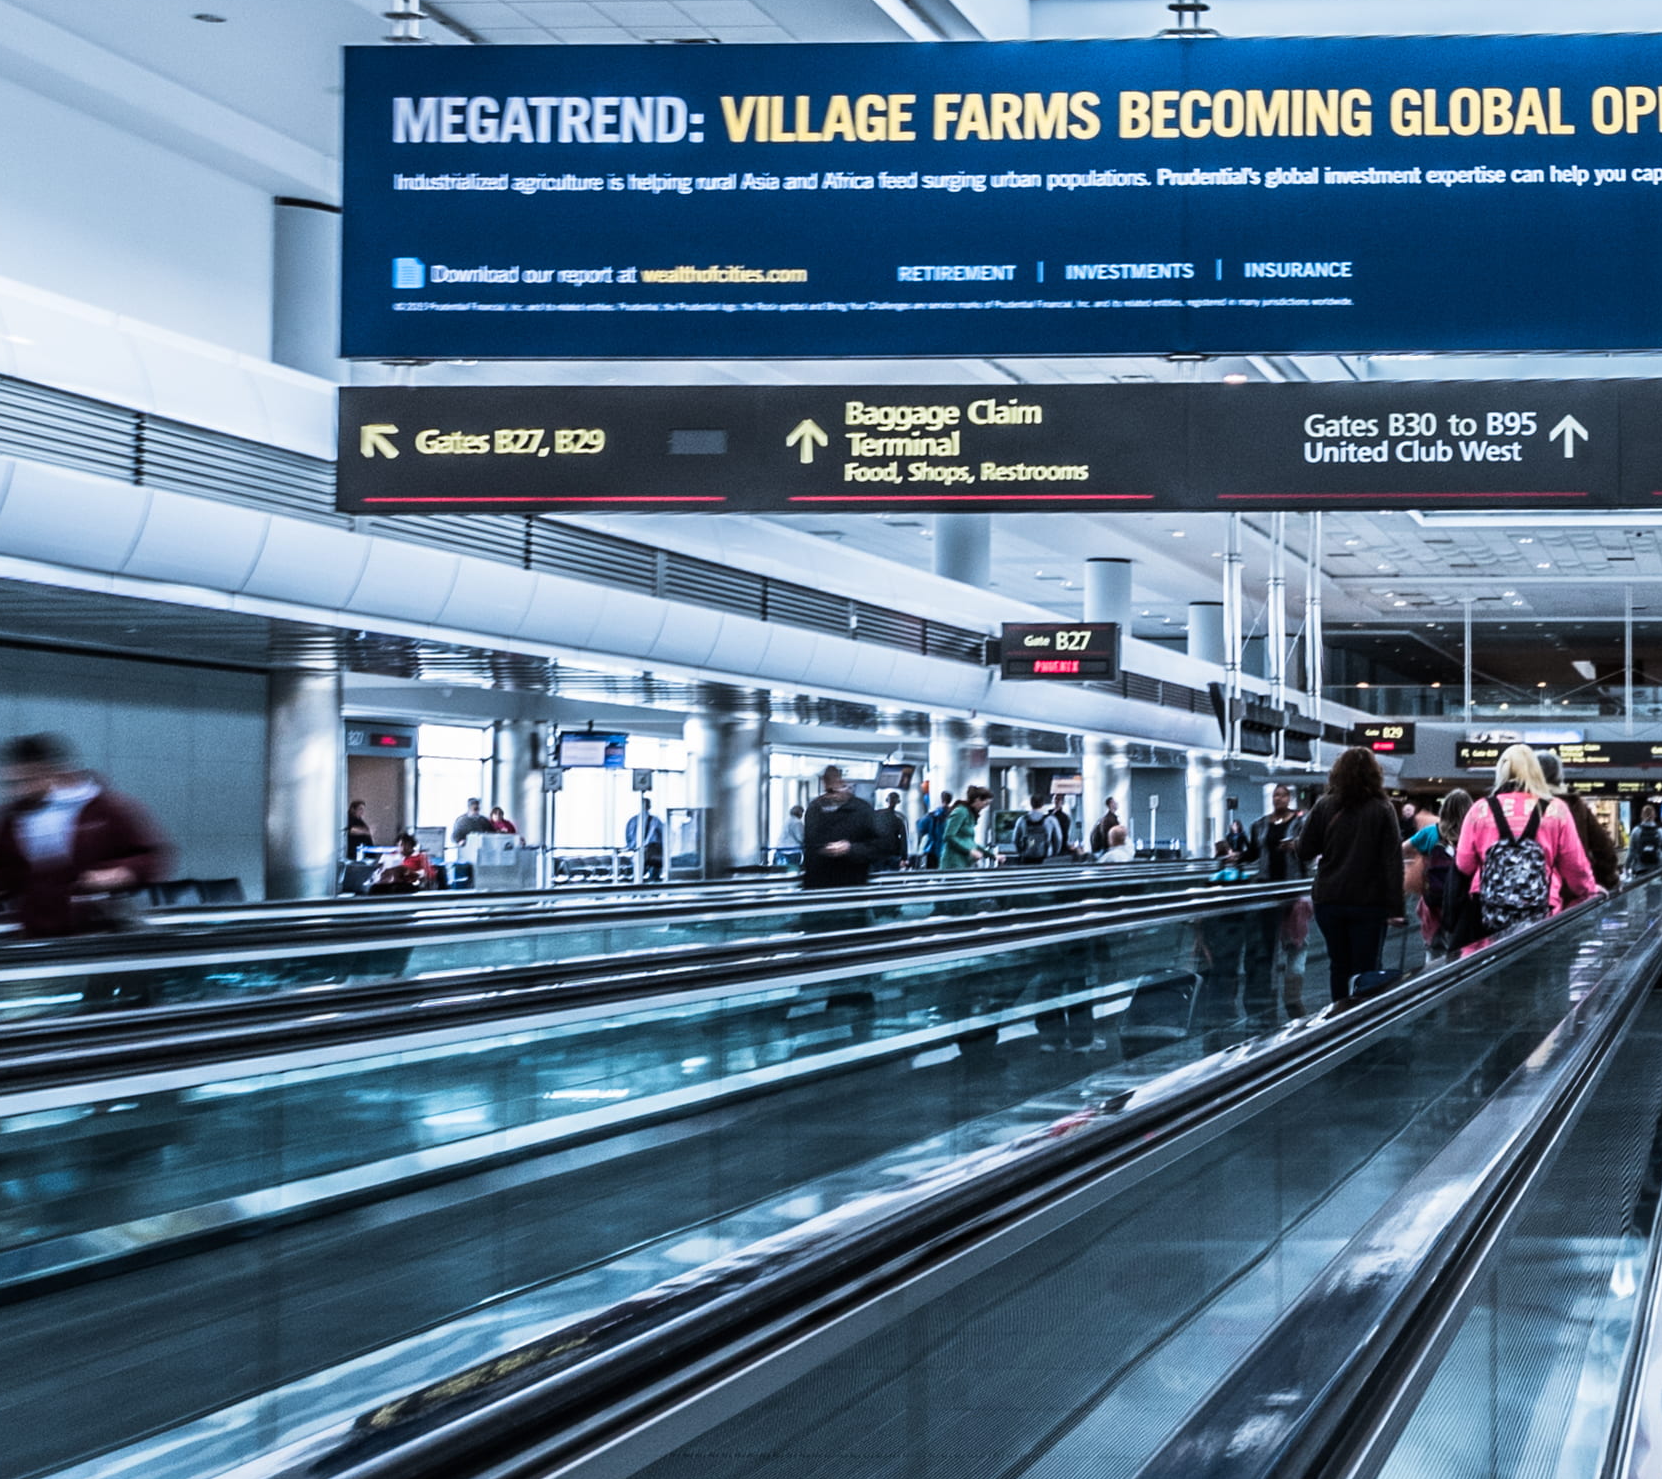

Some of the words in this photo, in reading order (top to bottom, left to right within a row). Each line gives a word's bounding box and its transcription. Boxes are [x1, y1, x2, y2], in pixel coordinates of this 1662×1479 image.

[393, 96, 704, 143] MEGATREND:
[720, 94, 916, 142] VILLAGE
[933, 91, 1101, 140] FARMS
[1119, 87, 1372, 139] BECOMING
[1390, 86, 1576, 137] GLOBAL
[393, 172, 509, 191] Industrialized
[510, 172, 604, 195] agriculture
[606, 172, 625, 191] is
[627, 172, 693, 195] helping
[695, 172, 737, 191] rural
[740, 172, 780, 190] Asia
[783, 172, 818, 190] and
[821, 171, 875, 189] Africa
[878, 170, 918, 189] feed
[921, 170, 987, 192] surging
[990, 170, 1042, 188] urban
[1046, 167, 1152, 191] populations.
[1156, 166, 1261, 186] Prudential's
[1264, 167, 1319, 189] global
[1324, 166, 1422, 185] investment
[1425, 165, 1507, 187] expertise
[1510, 168, 1545, 184] can
[1550, 164, 1590, 186] help
[1594, 166, 1626, 186] you
[430, 264, 520, 284] Download
[522, 268, 554, 284] our
[557, 266, 613, 287] report
[616, 265, 637, 283] at
[641, 264, 808, 283] wealthofcities.com
[898, 264, 1017, 282] RETIREMENT
[1065, 263, 1195, 280] INVESTMENTS
[1244, 261, 1353, 278] INSURANCE
[845, 401, 960, 431] Baggage
[967, 398, 1042, 424] Claim
[1304, 414, 1379, 437] Gates
[1388, 413, 1437, 436] B30
[1447, 414, 1477, 436] to
[1487, 411, 1537, 436] B95
[415, 429, 490, 455] Gates
[494, 428, 550, 457] B27,
[554, 428, 606, 454] B29
[845, 430, 960, 457] Terminal
[1304, 440, 1388, 463] United
[1395, 440, 1453, 462] Club
[1458, 440, 1522, 462] West
[844, 462, 902, 484] Food,
[907, 461, 975, 485] Shops,
[980, 462, 1089, 481] Restrooms
[1023, 634, 1050, 646] Gate
[1055, 630, 1092, 651] B27
